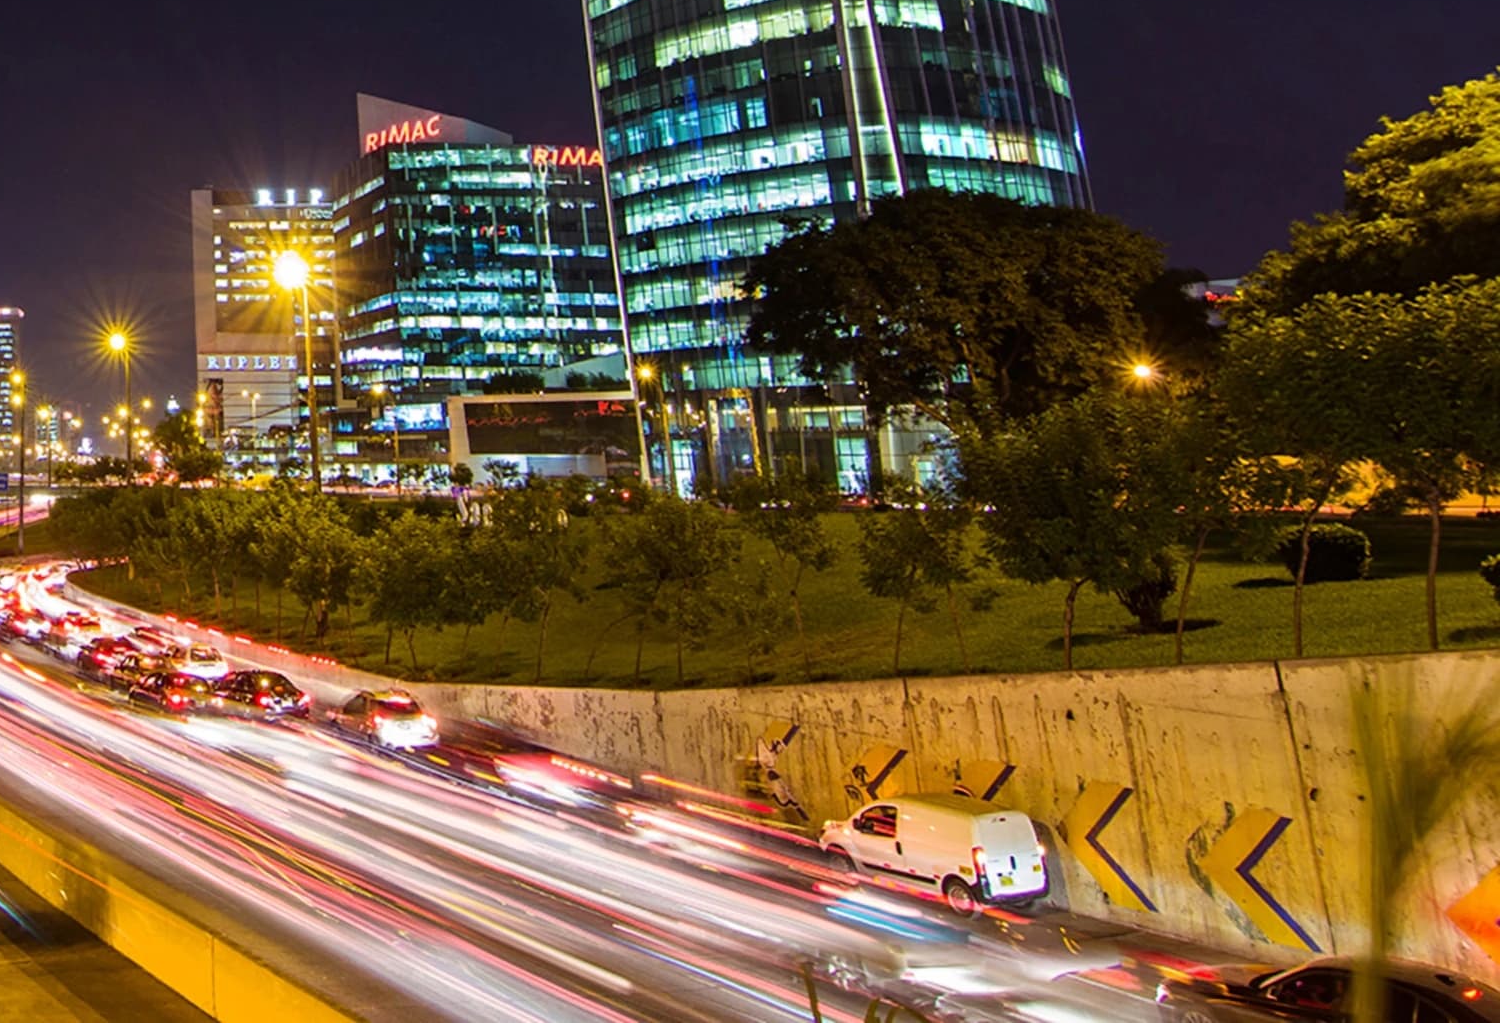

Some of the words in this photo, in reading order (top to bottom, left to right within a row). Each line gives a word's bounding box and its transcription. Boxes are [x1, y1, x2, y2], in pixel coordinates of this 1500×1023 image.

[364, 114, 442, 154] RIMAC
[533, 146, 604, 167] RIMA
[256, 188, 323, 206] RIP
